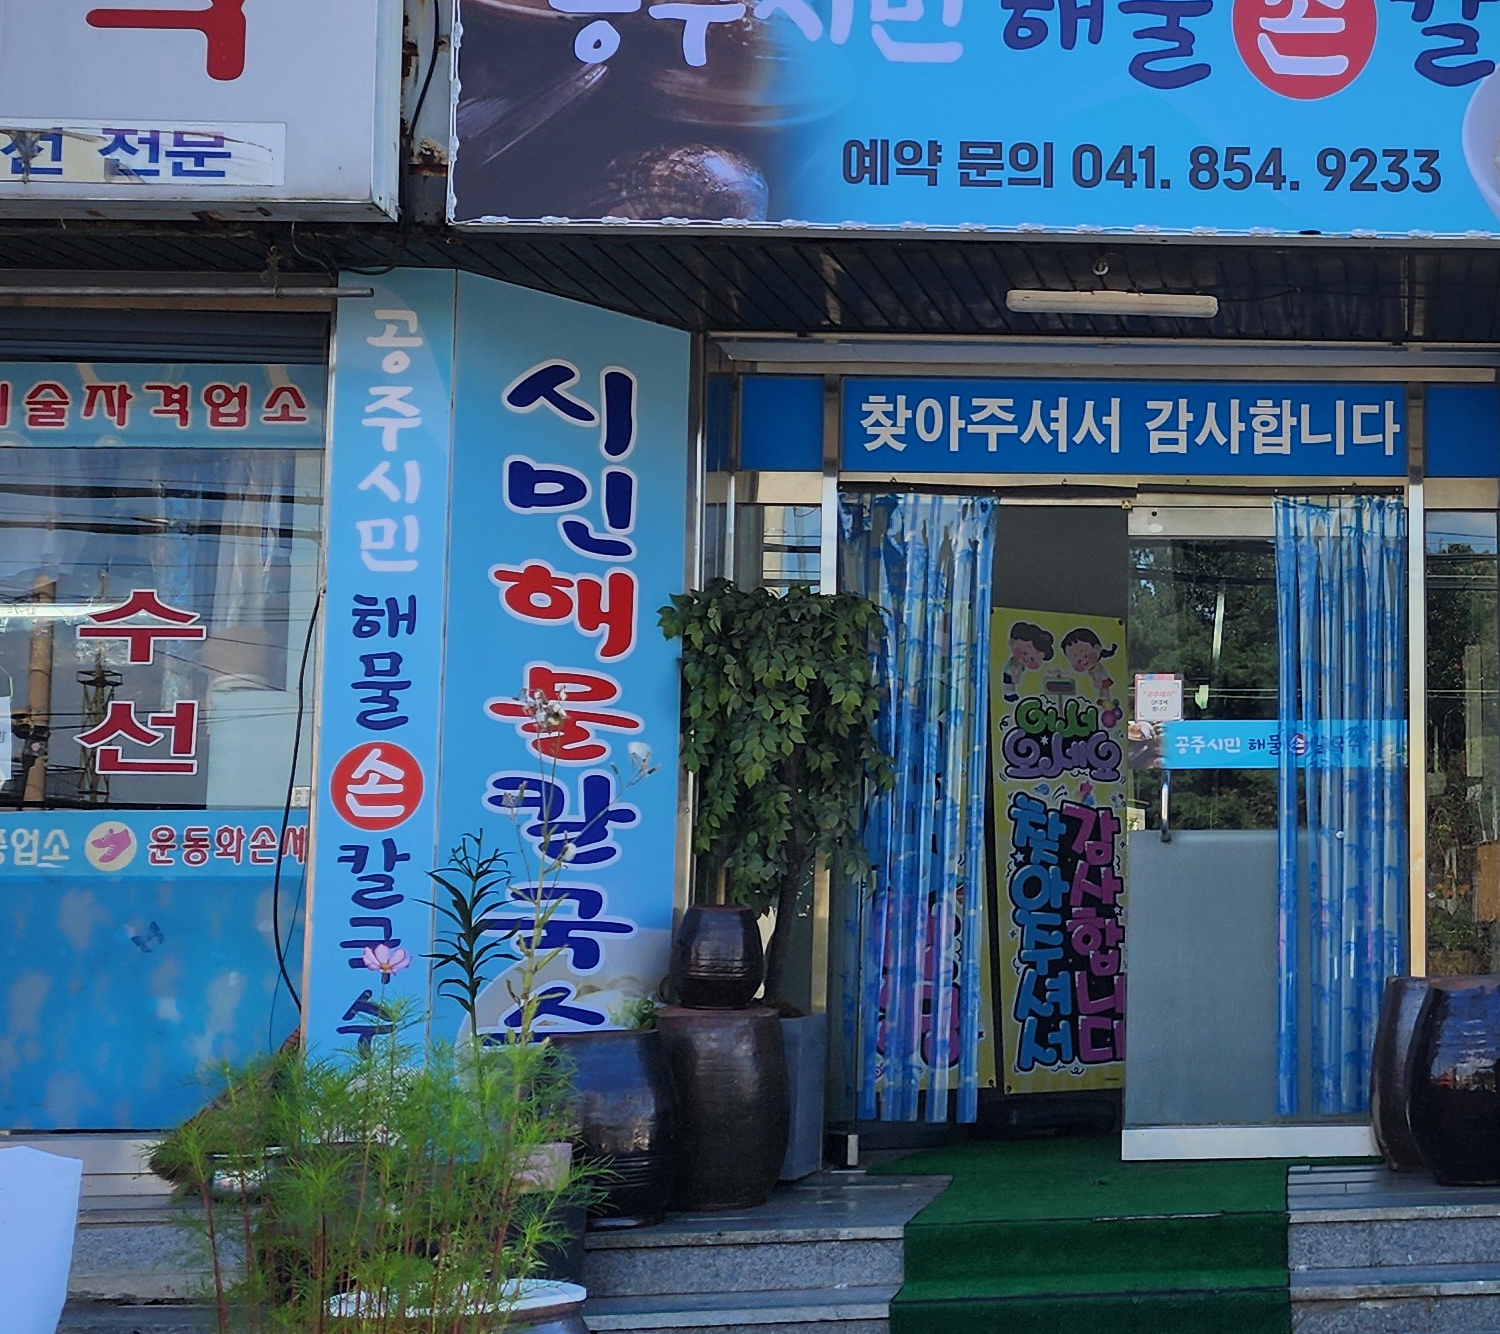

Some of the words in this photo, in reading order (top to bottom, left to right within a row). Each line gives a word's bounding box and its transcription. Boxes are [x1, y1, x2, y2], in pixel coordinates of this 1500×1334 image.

[97, 128, 232, 178] 전문
[841, 138, 943, 187] 예약
[956, 140, 1055, 189] 문의
[355, 308, 425, 572] 공주시민
[858, 394, 1122, 454] 찾아주셔서
[1144, 397, 1401, 457] 감사합니다
[350, 593, 418, 731] 해물
[1015, 697, 1098, 737] 어서
[1174, 735, 1242, 755] 공주시민
[345, 747, 405, 818] 손
[1003, 727, 1122, 781] 오세요
[1008, 792, 1073, 1071] 찾아주셔서
[1060, 800, 1127, 1063] 감사합니다
